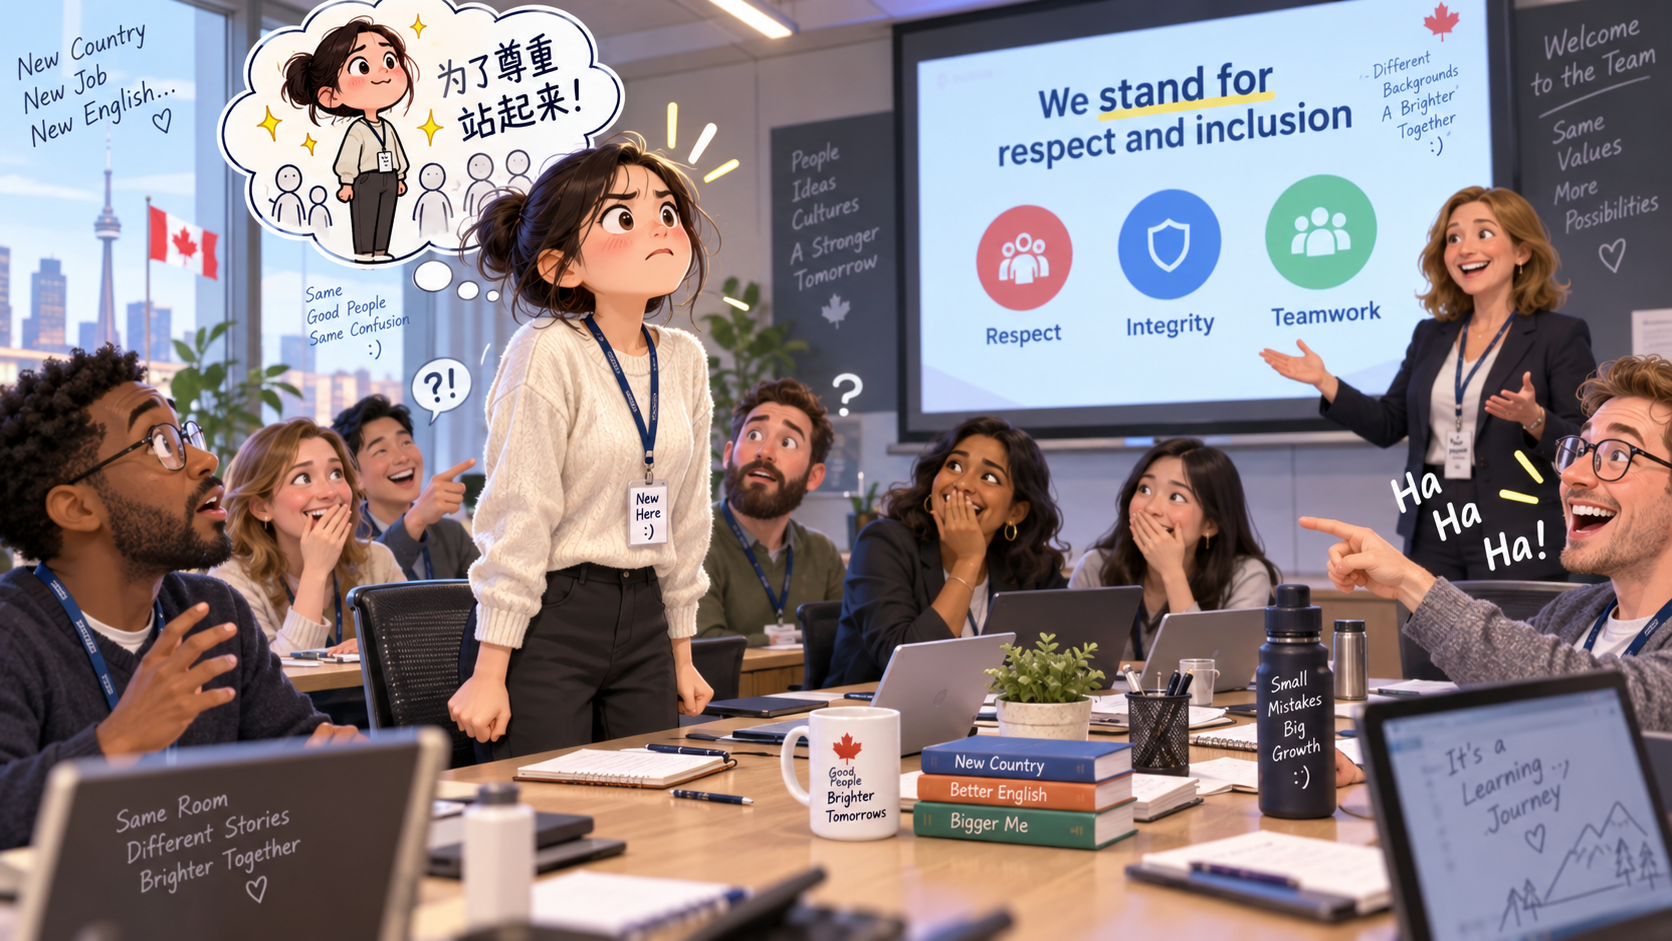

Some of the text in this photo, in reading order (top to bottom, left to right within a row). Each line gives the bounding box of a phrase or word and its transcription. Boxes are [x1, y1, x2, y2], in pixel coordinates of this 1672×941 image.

[18, 24, 146, 81] New Country
[1544, 19, 1641, 60] Welcome
[1372, 50, 1431, 79] Different
[1530, 48, 1656, 96] to the Team
[24, 63, 107, 114] New Job
[1038, 62, 1274, 119] We stand for
[1383, 63, 1459, 98] Backgrounds
[31, 80, 176, 148] New English...
[1381, 90, 1456, 122] A Brighter
[998, 101, 1353, 170] respect and inclusion
[1396, 113, 1457, 141] Together
[1552, 116, 1605, 145] Same
[791, 141, 840, 173] People
[1557, 138, 1622, 171] Values
[791, 176, 837, 203] Ideas
[1554, 180, 1598, 205] More
[791, 198, 860, 230] Cultures
[1565, 196, 1659, 234] Possibilities
[790, 226, 880, 266] A Stronger
[793, 254, 878, 291] Tomorrow
[305, 286, 343, 303] Same
[307, 295, 387, 325] Good People
[1271, 300, 1382, 326] Teamwork
[310, 315, 410, 347] Same Confusion
[986, 323, 1062, 348] Respect
[1126, 313, 1215, 339] Integrity
[636, 492, 659, 506] New
[636, 507, 661, 521] Here
[1271, 669, 1308, 693] Small
[1267, 694, 1322, 717] Mistakes
[1284, 720, 1306, 739] Big
[1272, 737, 1321, 762] Growth
[1445, 742, 1483, 776] It's
[1494, 739, 1507, 754] a
[828, 766, 855, 779] Good
[954, 754, 1045, 777] New Country
[829, 774, 862, 789] People
[950, 782, 1047, 805] Better English
[1461, 758, 1543, 807] Learning
[116, 794, 229, 833] Same Room
[827, 790, 875, 808] Brighter
[1487, 784, 1561, 834] Journey
[825, 808, 887, 823] Tomorrows
[950, 812, 1029, 835] Bigger Me
[126, 810, 290, 864] Different Stories
[140, 838, 301, 894] Brighter Together
